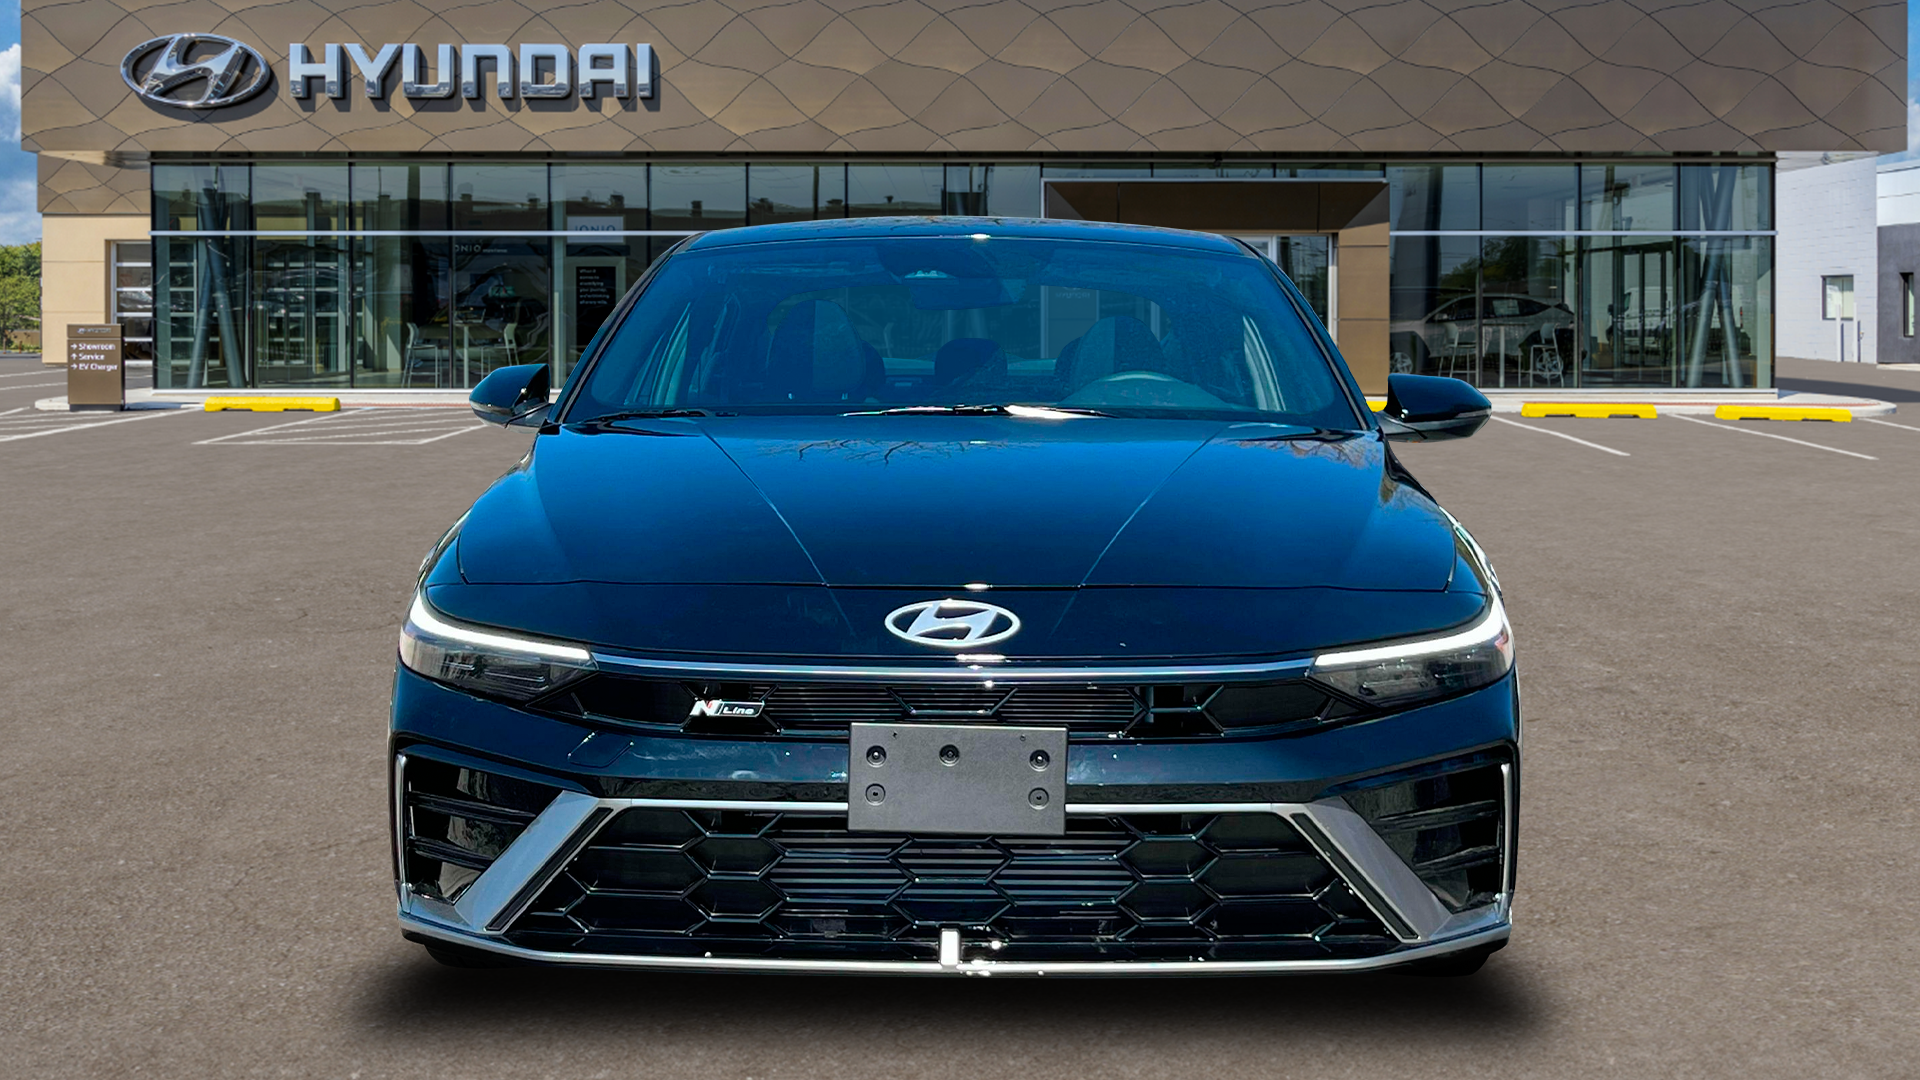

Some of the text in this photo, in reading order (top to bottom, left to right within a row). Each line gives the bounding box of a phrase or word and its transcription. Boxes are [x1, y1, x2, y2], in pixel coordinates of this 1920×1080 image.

[289, 43, 654, 99] HYUNDAI
[79, 343, 116, 351] Showroom
[90, 363, 118, 372] Charger
[689, 700, 755, 716] N Line
